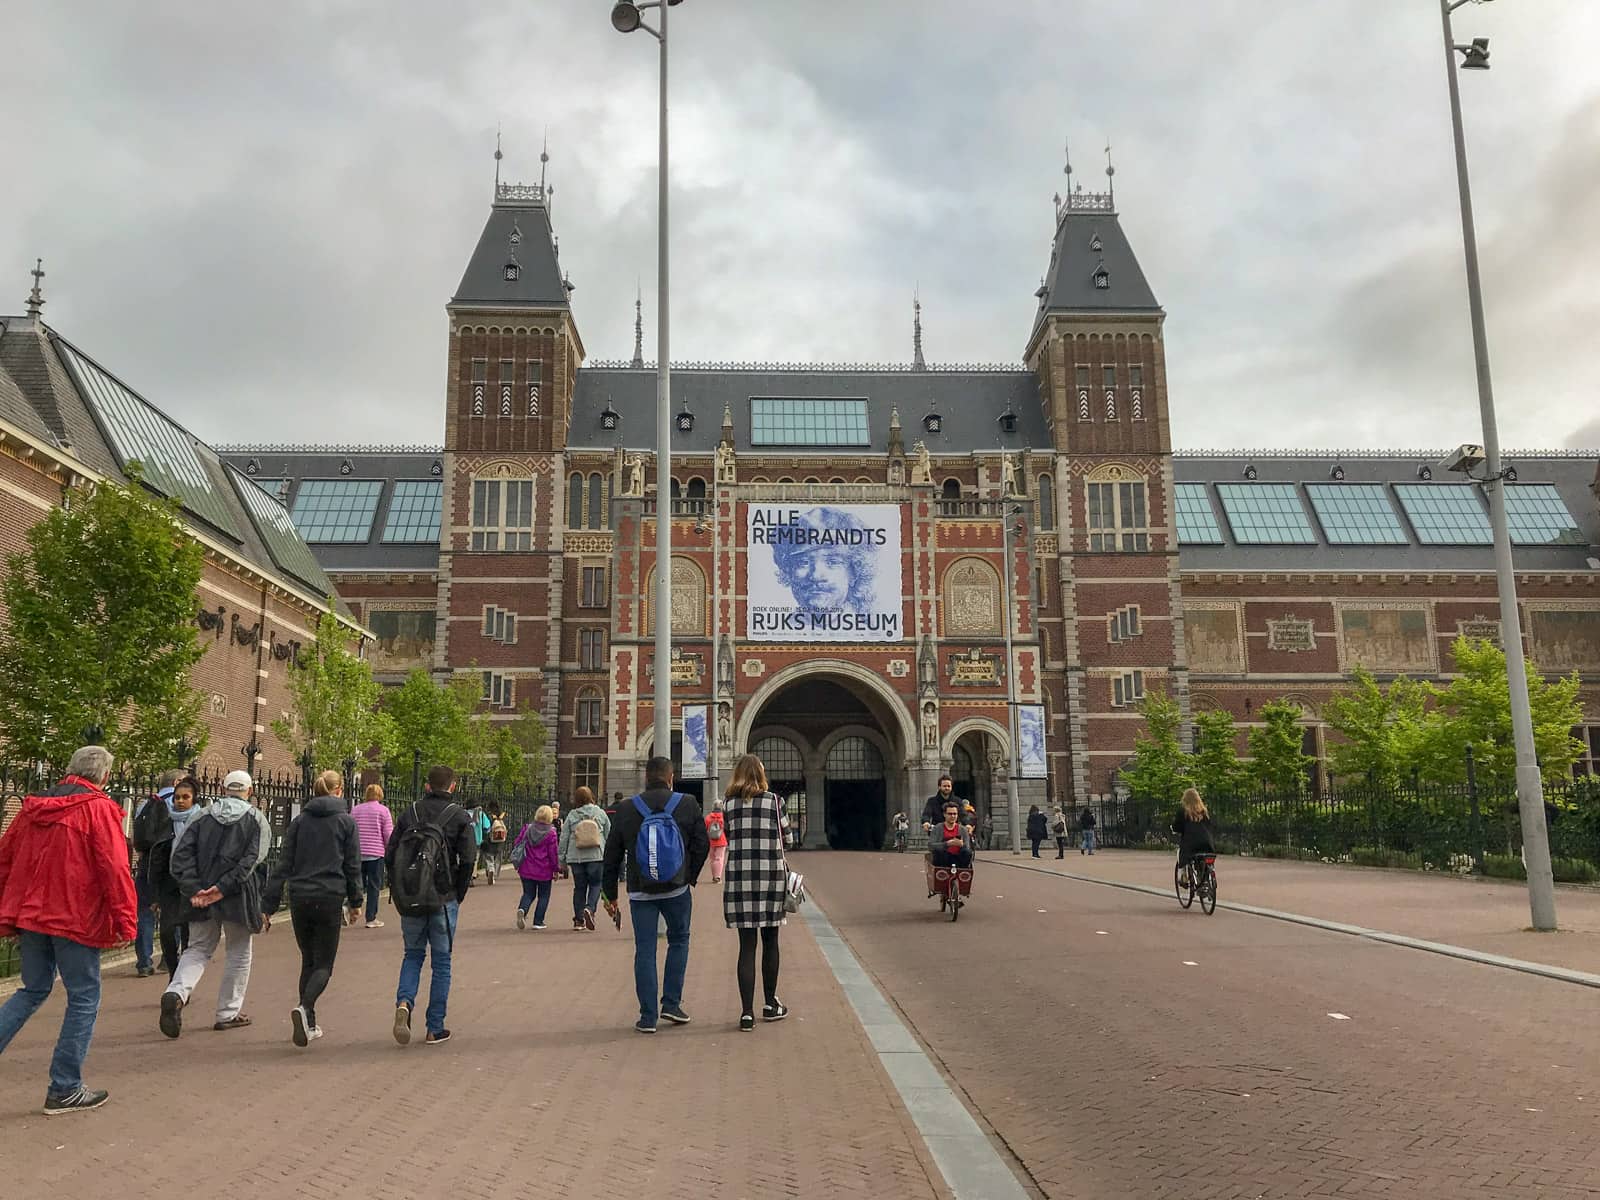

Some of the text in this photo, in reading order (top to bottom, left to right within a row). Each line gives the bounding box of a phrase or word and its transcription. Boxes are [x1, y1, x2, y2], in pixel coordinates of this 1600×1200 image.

[752, 509, 799, 526] ALLE
[752, 527, 886, 545] REMBRANDTS
[752, 613, 897, 631] RIJKS MUSEUM
